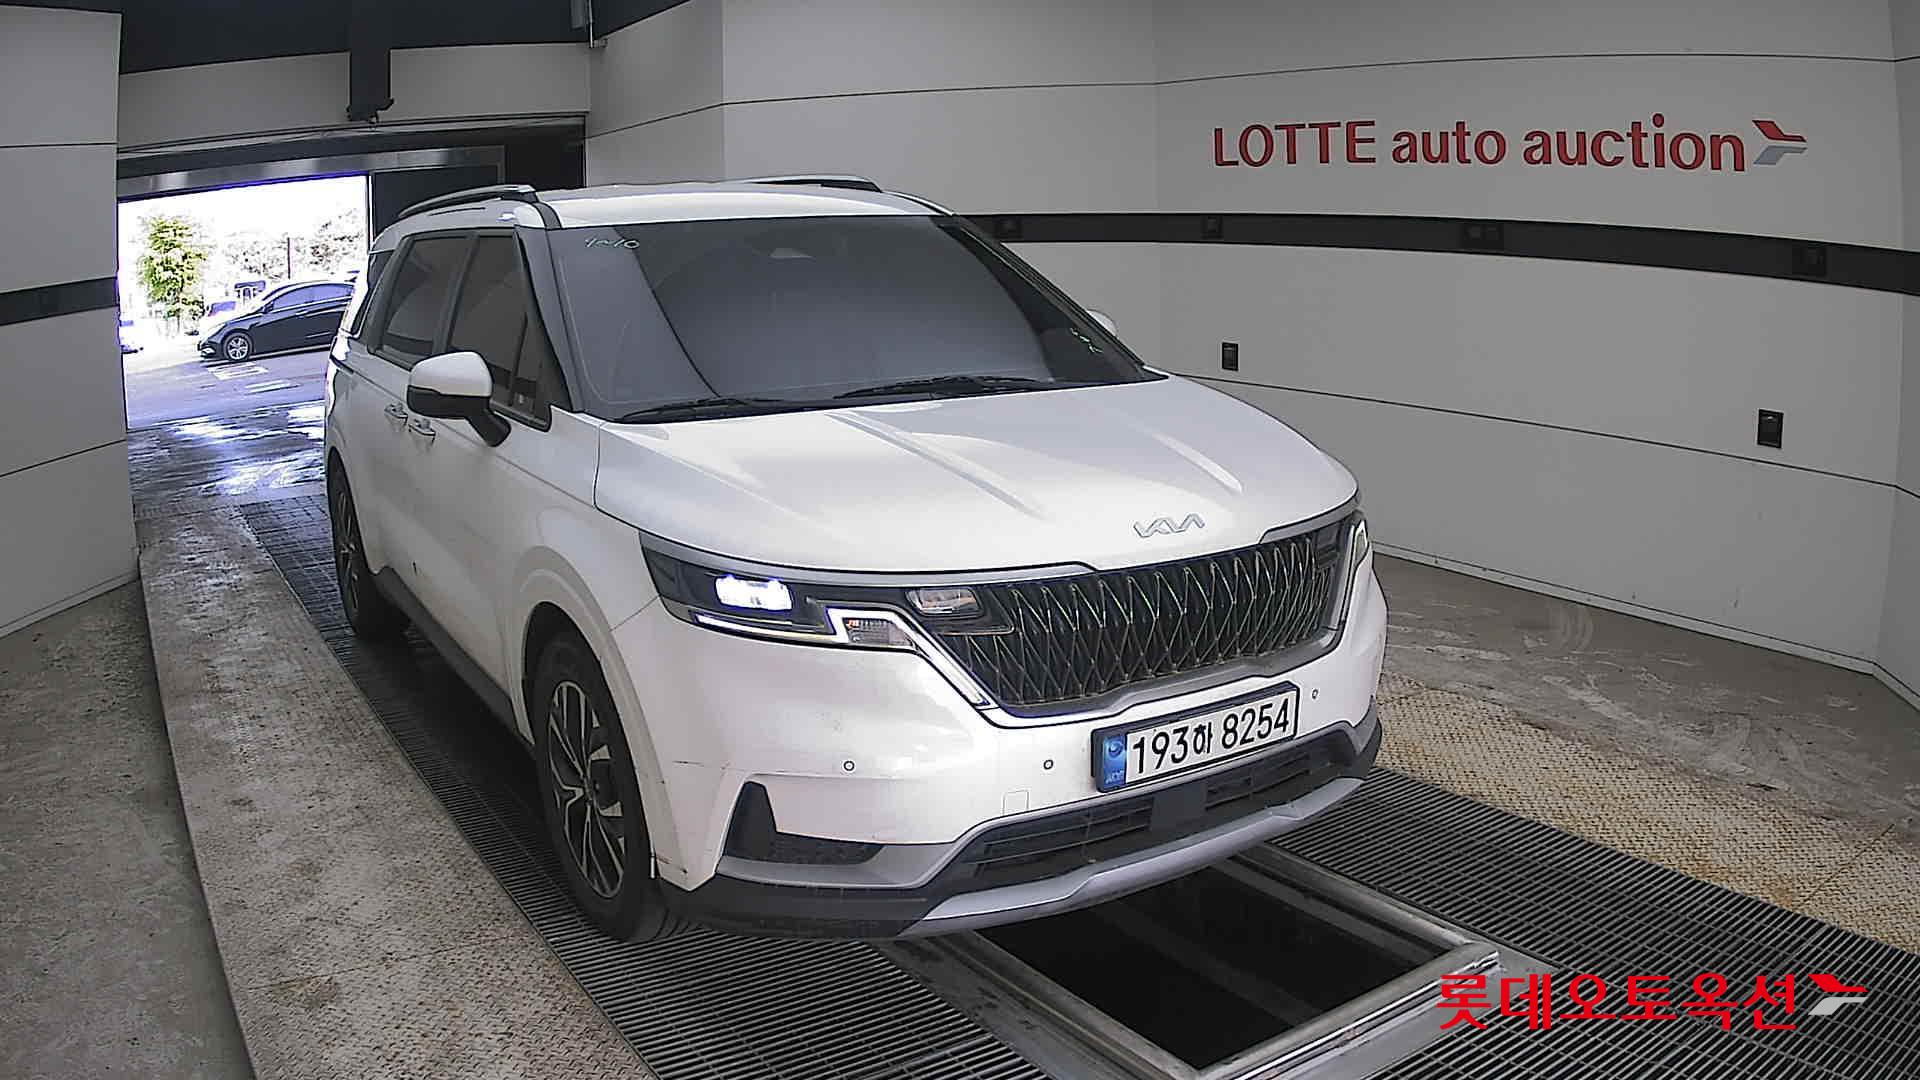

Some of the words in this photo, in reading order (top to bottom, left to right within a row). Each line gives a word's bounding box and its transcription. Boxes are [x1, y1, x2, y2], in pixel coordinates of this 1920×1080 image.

[1213, 119, 1377, 167] LOTTE
[1391, 121, 1507, 165] auto
[1522, 113, 1746, 173] auction
[1132, 512, 1206, 539] KIA
[1132, 721, 1213, 774] 193하
[1221, 698, 1290, 750] 8254
